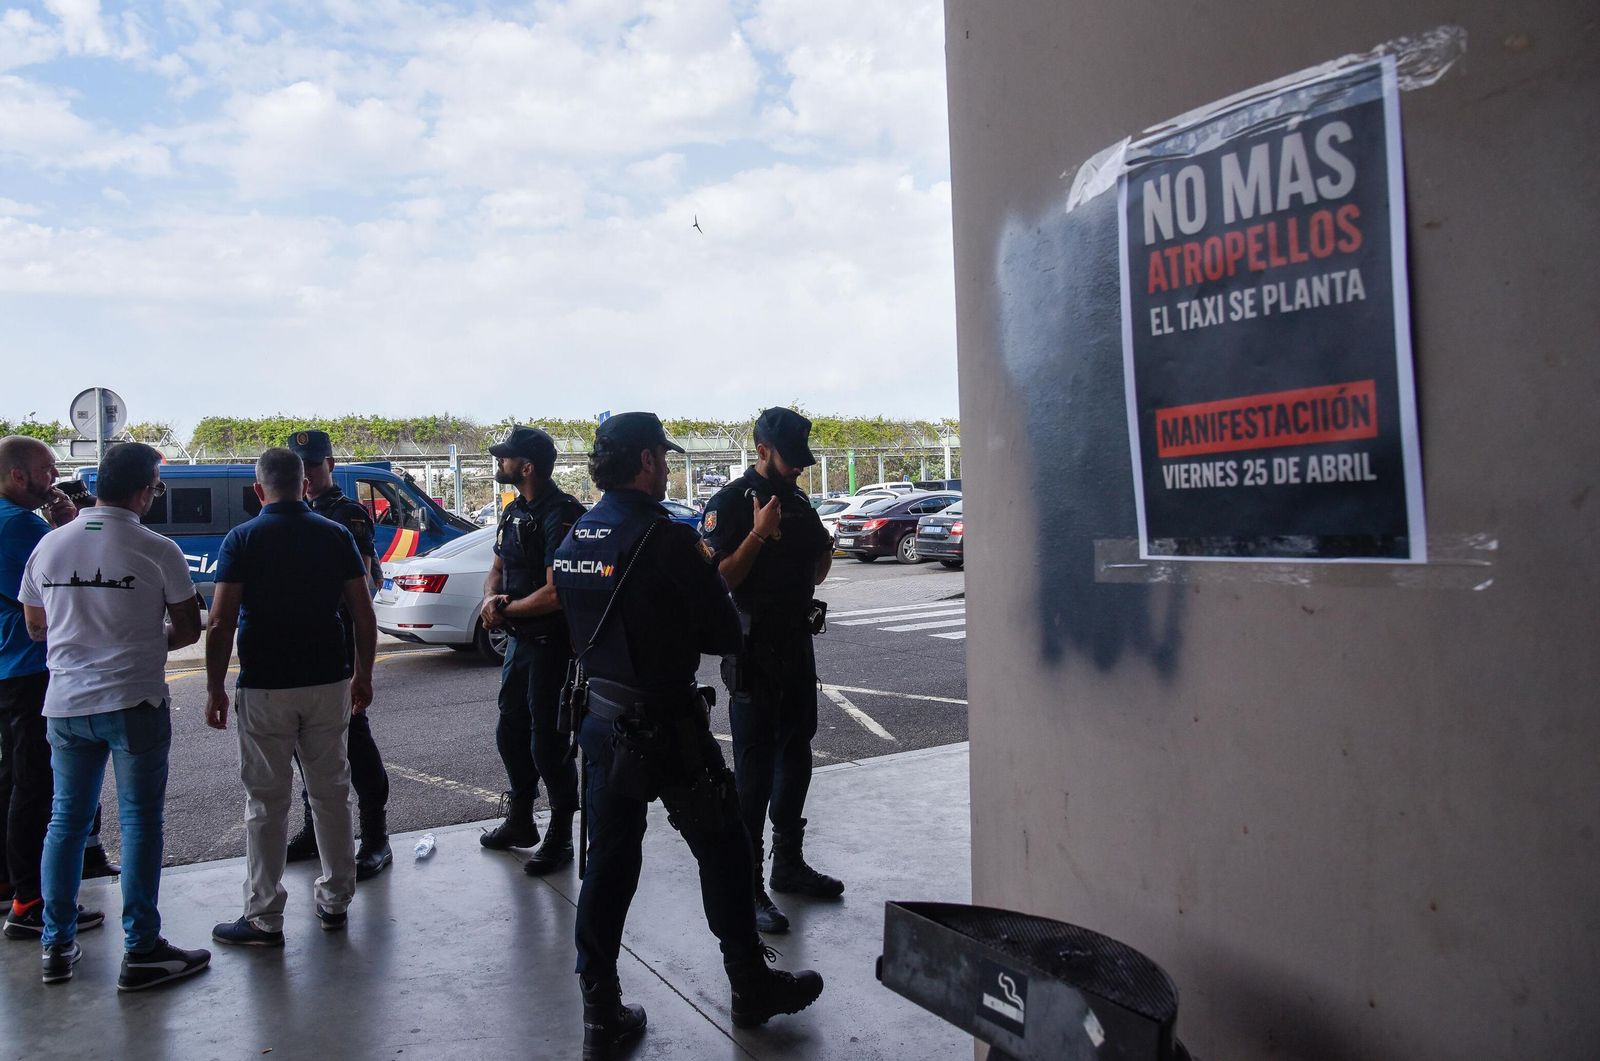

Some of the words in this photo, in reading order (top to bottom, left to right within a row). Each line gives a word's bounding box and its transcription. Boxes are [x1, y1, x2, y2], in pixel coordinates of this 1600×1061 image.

[1143, 165, 1208, 246] NO
[1220, 115, 1356, 224] MÁS
[1148, 203, 1363, 295] ATROPELLOS
[1150, 306, 1174, 336] EL
[1177, 295, 1224, 331] TAXI
[1229, 288, 1257, 321] SE
[1263, 268, 1366, 314] PLANTA
[1162, 461, 1239, 490] VIERNES
[1243, 460, 1268, 486] 25
[1273, 456, 1300, 485] DE
[1306, 452, 1378, 484] ABRIL
[553, 559, 605, 575] POLICIA
